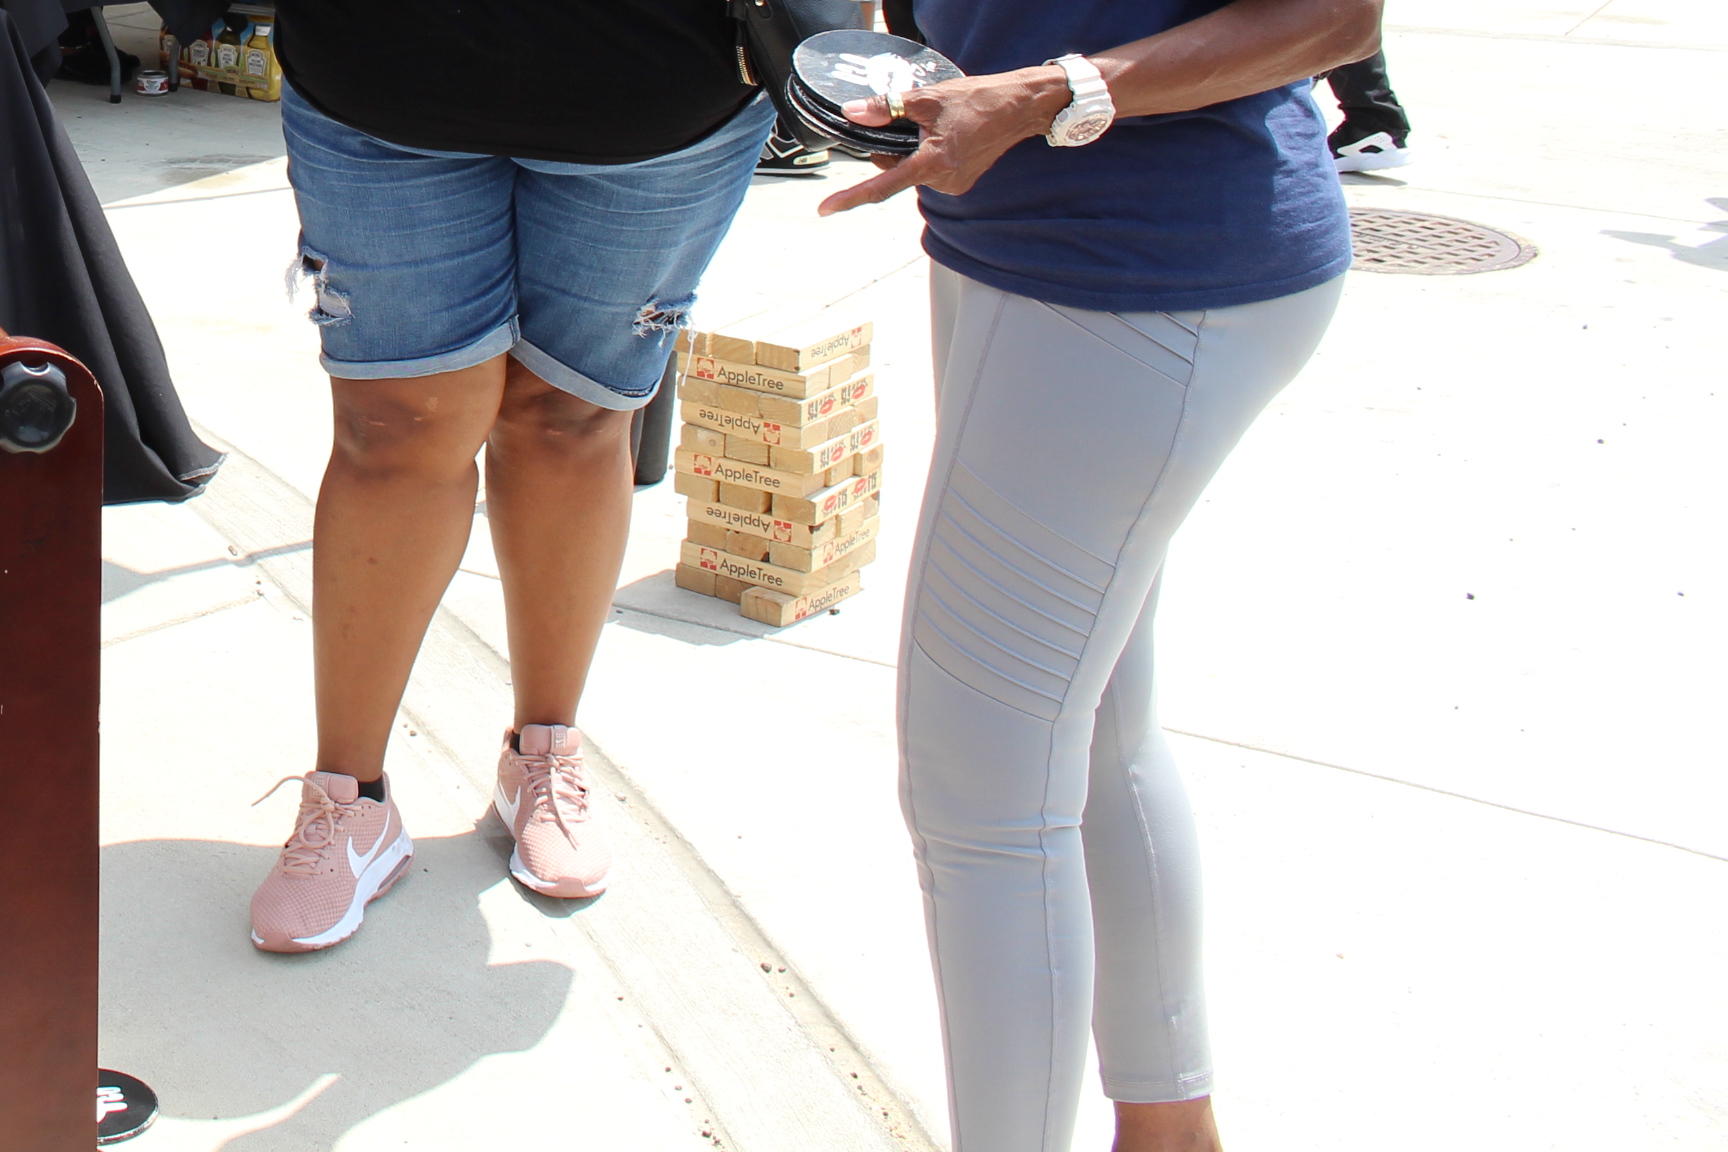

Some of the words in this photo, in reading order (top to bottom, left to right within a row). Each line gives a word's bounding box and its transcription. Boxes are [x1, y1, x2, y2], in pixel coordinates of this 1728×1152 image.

[810, 334, 850, 358] AppleTree
[717, 366, 784, 391] AppleTree
[698, 408, 761, 434] AppleTree
[714, 464, 781, 488] AppleTree
[705, 507, 771, 532] AppleTree
[834, 527, 870, 555] AppleTree
[719, 558, 783, 587] AppleTree
[808, 583, 850, 612] AppleTree
